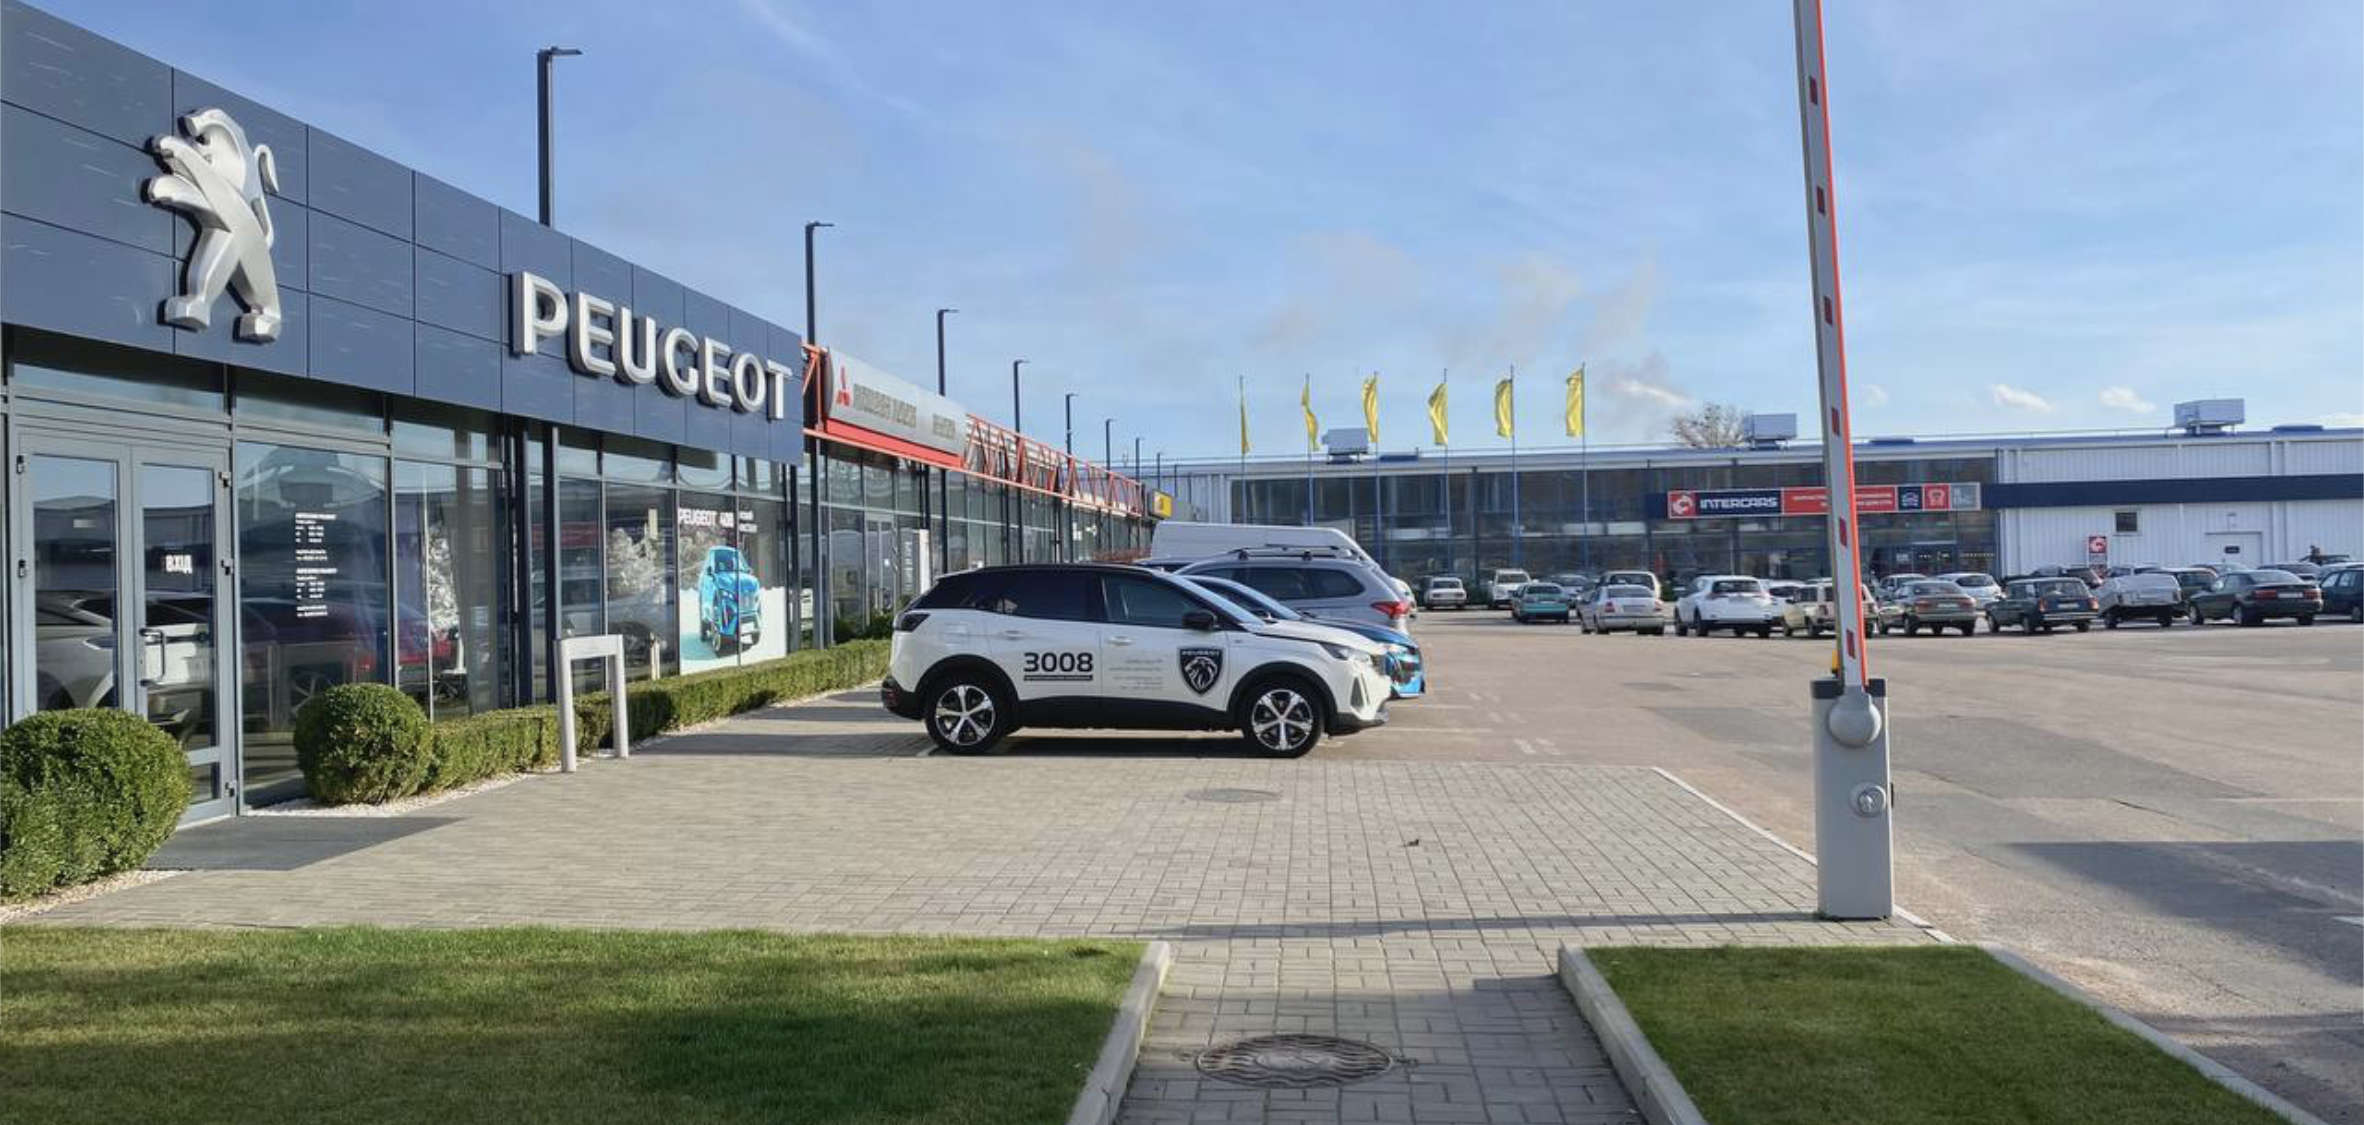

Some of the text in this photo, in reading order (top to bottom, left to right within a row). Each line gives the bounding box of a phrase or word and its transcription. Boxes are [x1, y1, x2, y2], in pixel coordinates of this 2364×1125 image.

[512, 270, 793, 421] PEUGEOT
[1699, 496, 1778, 509] INTERCARS
[1024, 652, 1093, 672] 3008
